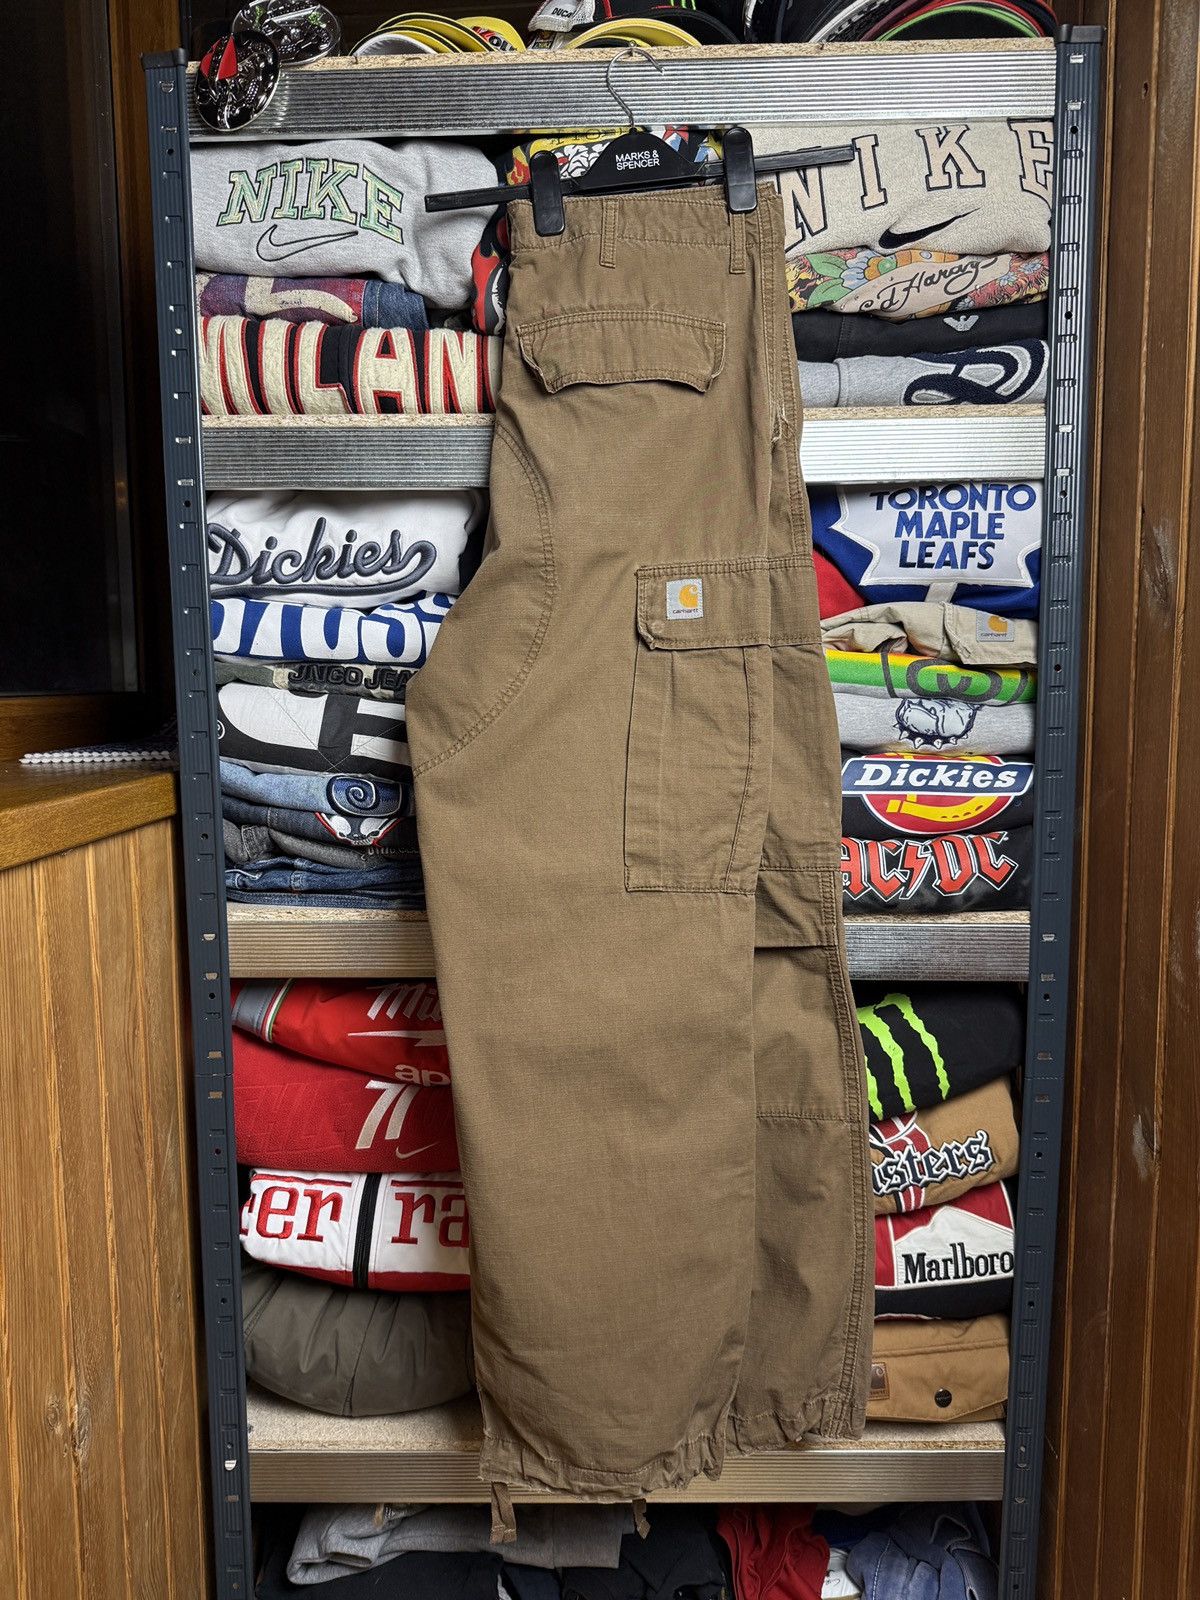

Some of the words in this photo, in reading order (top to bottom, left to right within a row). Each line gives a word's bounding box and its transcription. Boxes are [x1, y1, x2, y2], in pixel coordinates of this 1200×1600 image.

[615, 151, 651, 162] MARKS
[652, 150, 660, 159] &
[616, 159, 660, 171] SPENCER
[775, 117, 1053, 252] NIKE
[216, 158, 404, 245] NIKE
[200, 315, 497, 414] MILAN
[870, 482, 1037, 511] TORONTO
[895, 511, 1005, 540] MAPLE
[204, 516, 437, 588] Dickies
[899, 540, 996, 570] LEAFS
[288, 664, 364, 686] JNCO
[364, 668, 418, 690] JEA
[854, 763, 1018, 788] Dickies
[902, 1243, 1014, 1284] Marlboro
